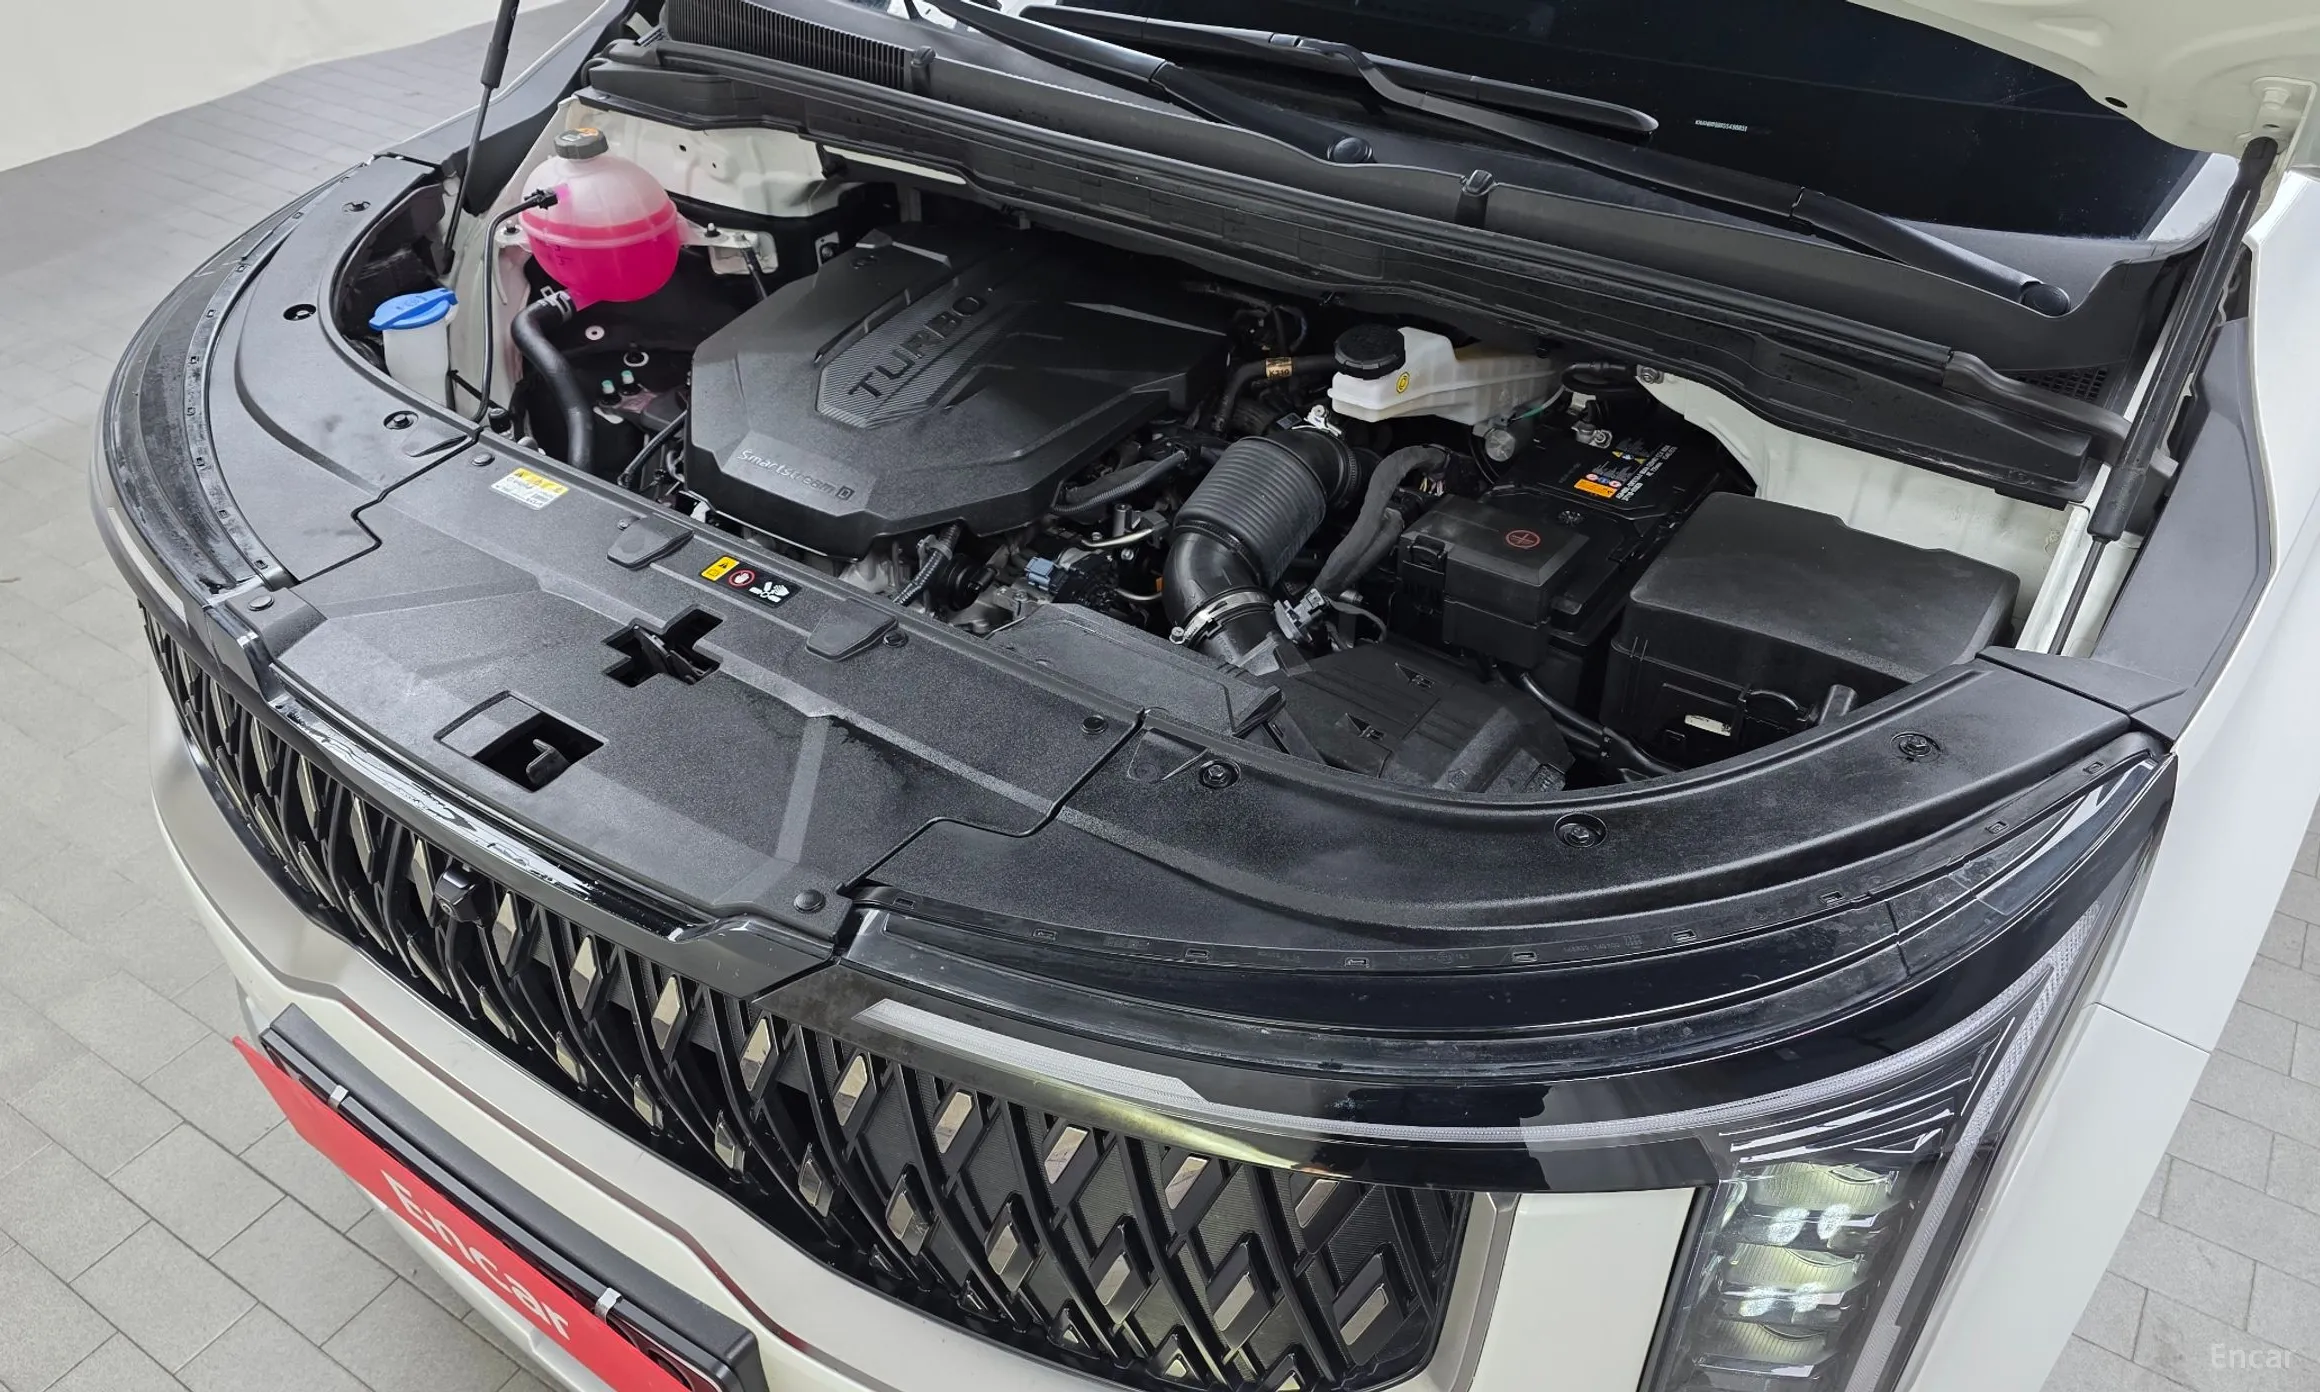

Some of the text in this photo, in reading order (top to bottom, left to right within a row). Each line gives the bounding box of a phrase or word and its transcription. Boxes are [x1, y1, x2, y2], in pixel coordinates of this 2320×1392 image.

[848, 296, 987, 398] TURBO
[737, 448, 837, 495] Smartstream
[380, 1169, 570, 1341] Encar
